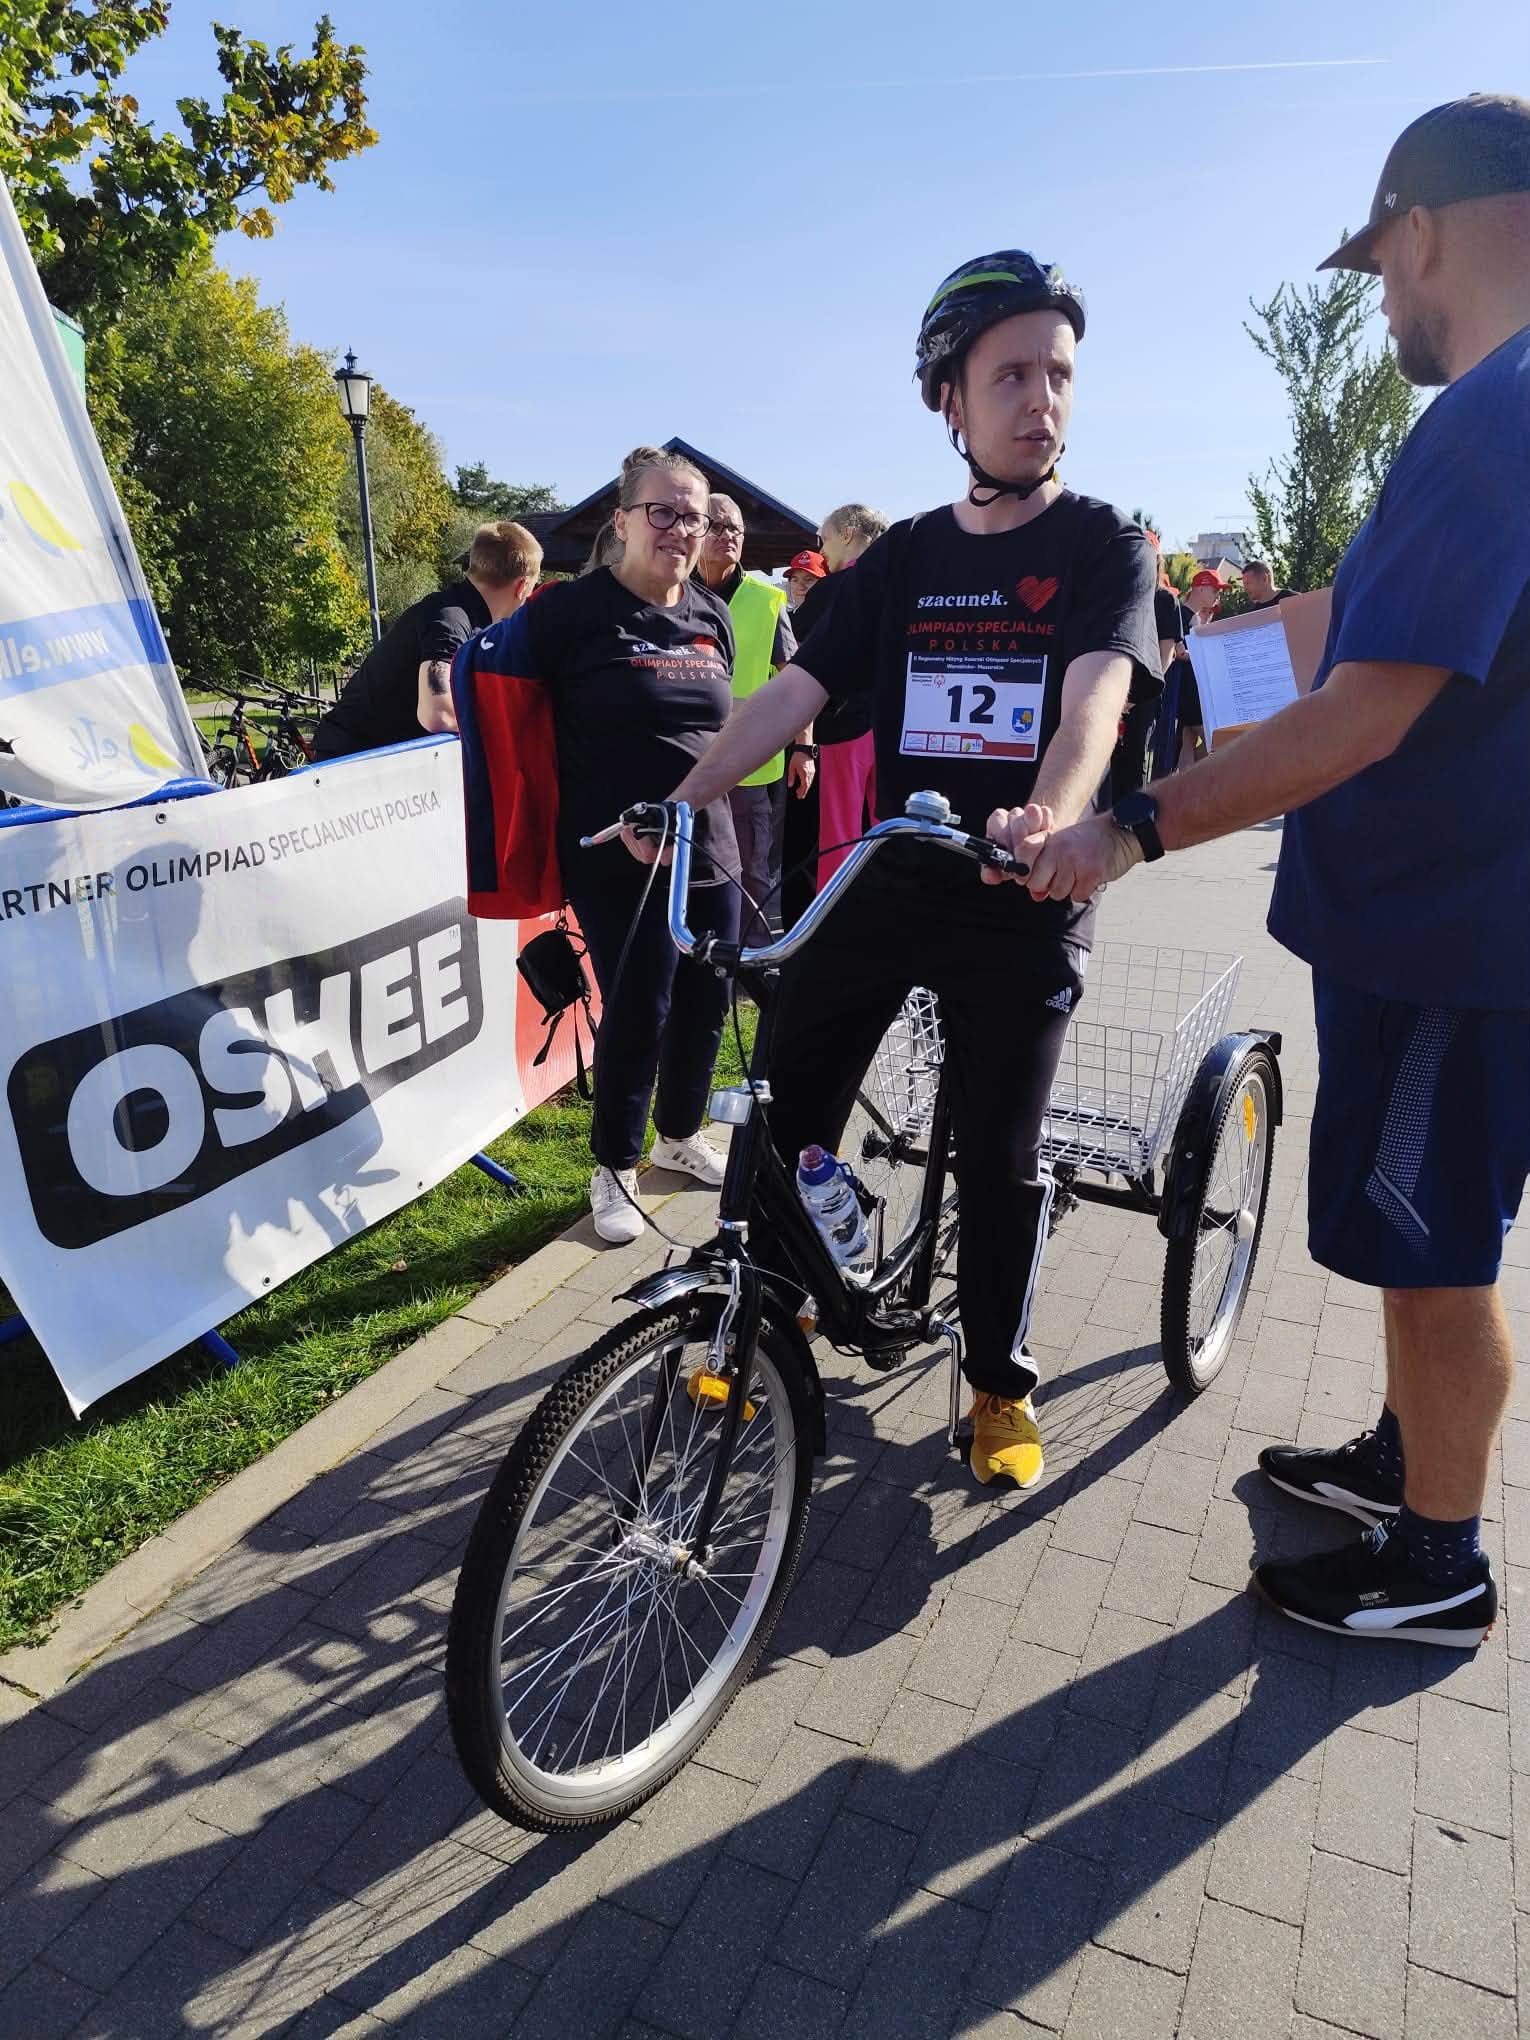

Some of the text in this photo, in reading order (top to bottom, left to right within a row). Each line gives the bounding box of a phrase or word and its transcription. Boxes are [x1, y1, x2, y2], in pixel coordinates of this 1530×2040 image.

[917, 590, 1008, 609] szacunek.
[976, 620, 1056, 636] SPECJALNE
[929, 639, 1018, 651] POLSKA
[657, 671, 717, 680] POLSKA
[947, 685, 997, 724] 12
[0, 789, 441, 921] RTNER OLIMPIAD SPECJALNYCH POLSKA
[67, 925, 470, 1197] OSHEE
